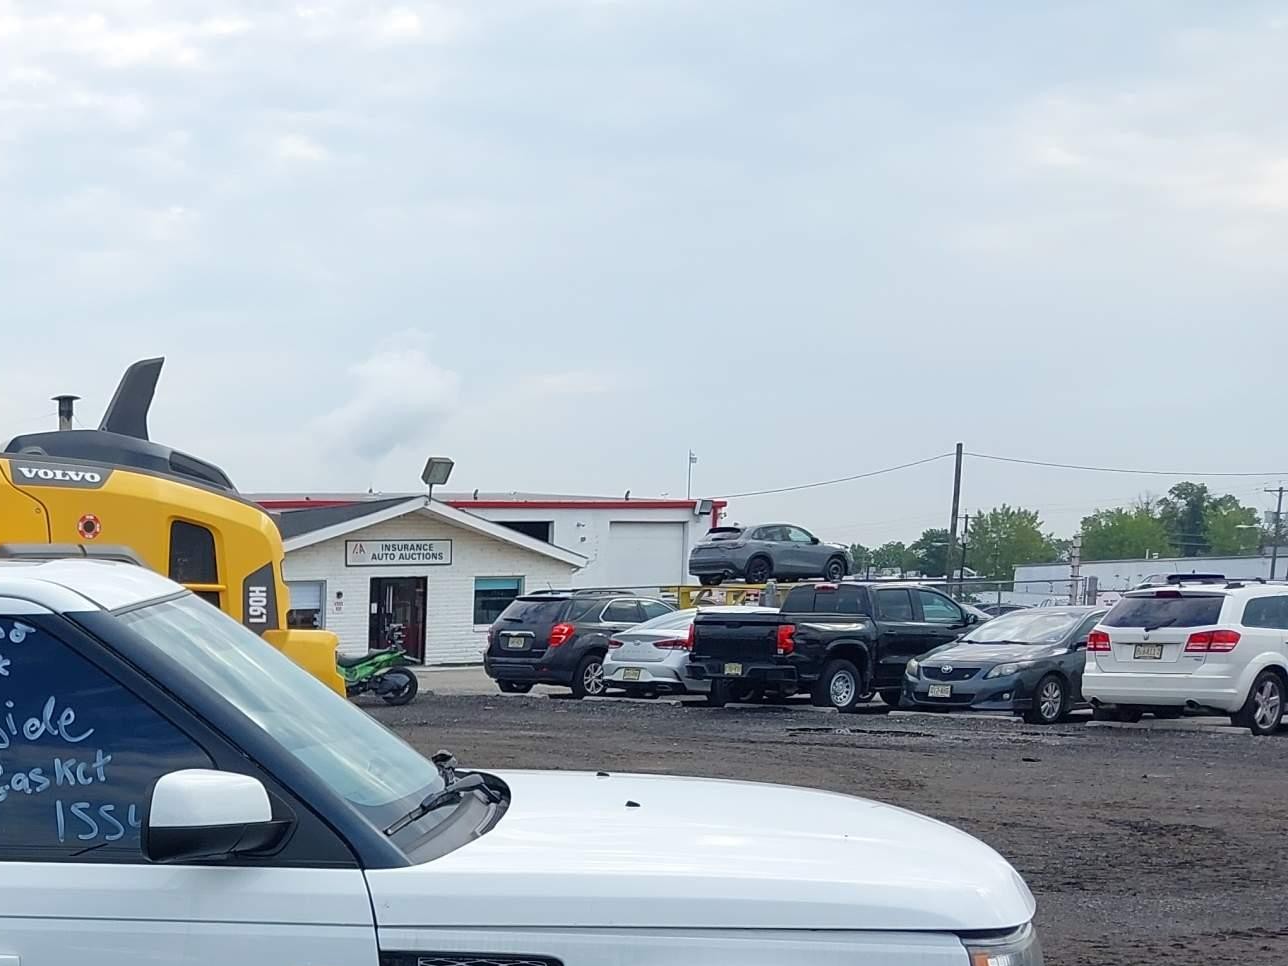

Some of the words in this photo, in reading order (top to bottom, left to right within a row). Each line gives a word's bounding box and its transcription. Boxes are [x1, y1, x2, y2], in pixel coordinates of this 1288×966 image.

[17, 467, 101, 483] VOLVO
[381, 543, 434, 552] INSURANCE
[370, 552, 396, 561] AUTO
[398, 552, 444, 561] AUCTIONS
[248, 586, 267, 624] L90H
